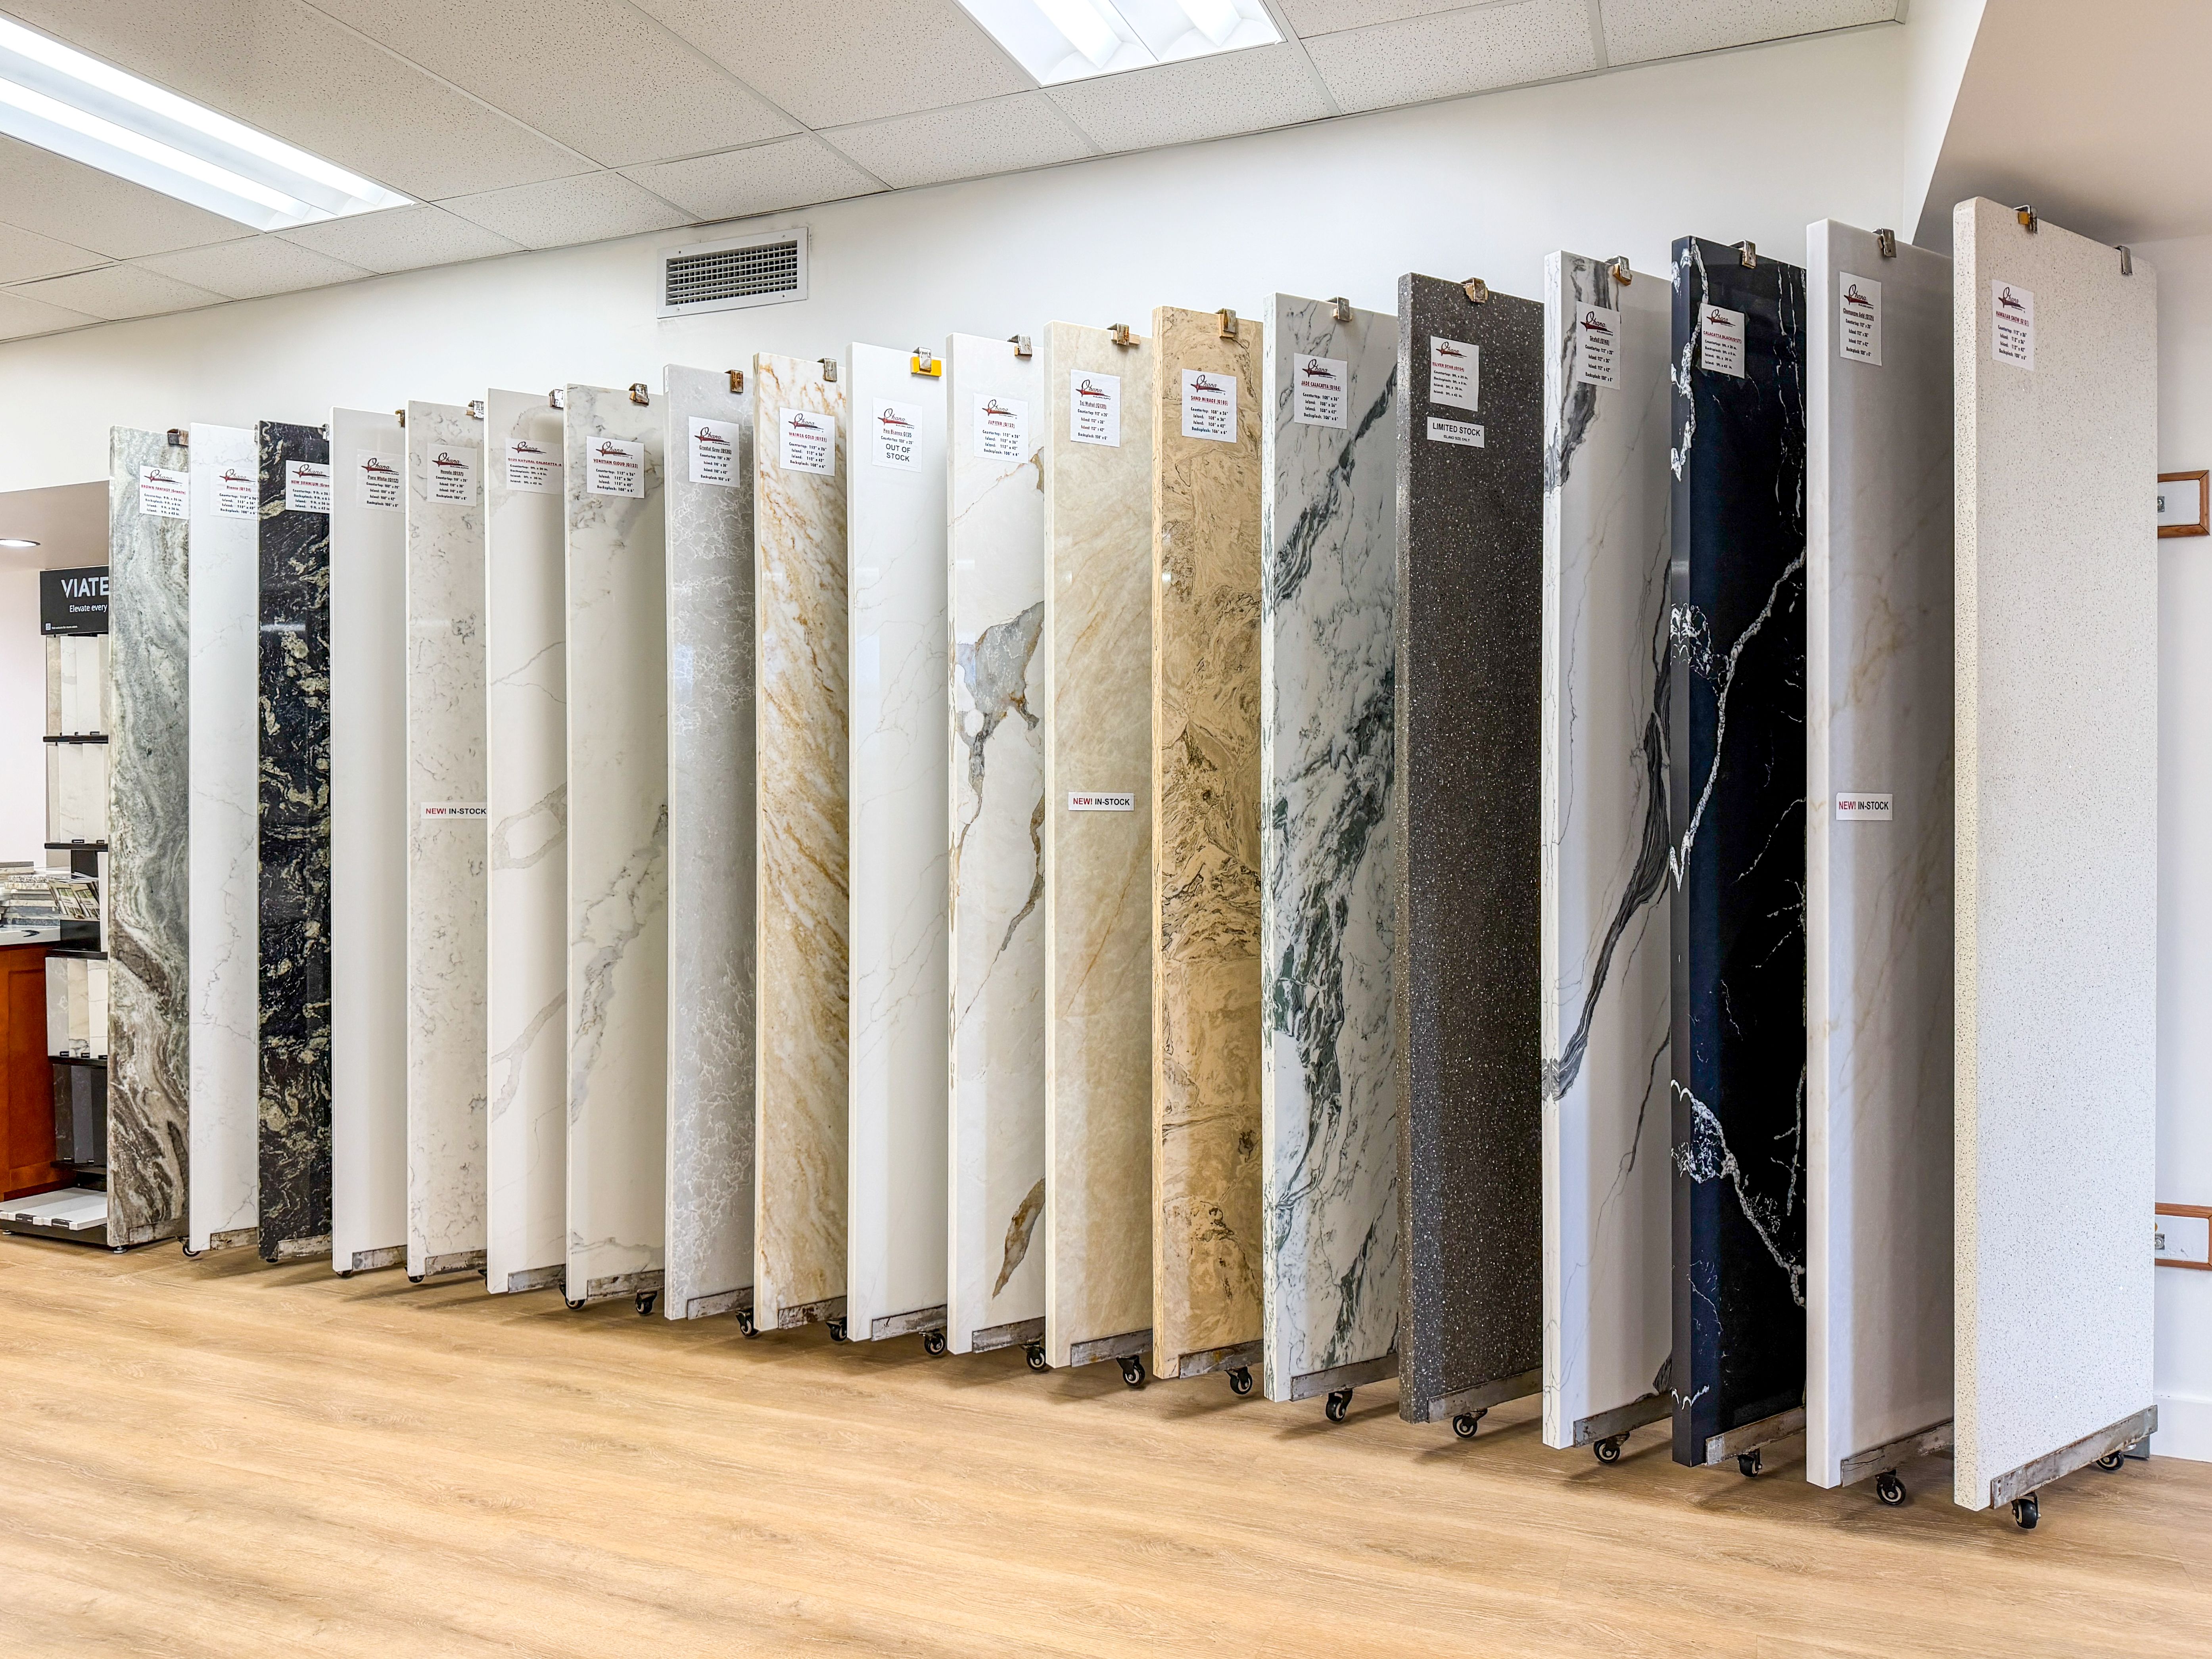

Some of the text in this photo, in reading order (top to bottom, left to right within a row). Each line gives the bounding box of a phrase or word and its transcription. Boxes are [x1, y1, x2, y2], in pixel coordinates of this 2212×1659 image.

[1433, 422, 1480, 436] LIMITED STOCK
[887, 453, 909, 462] STOCK
